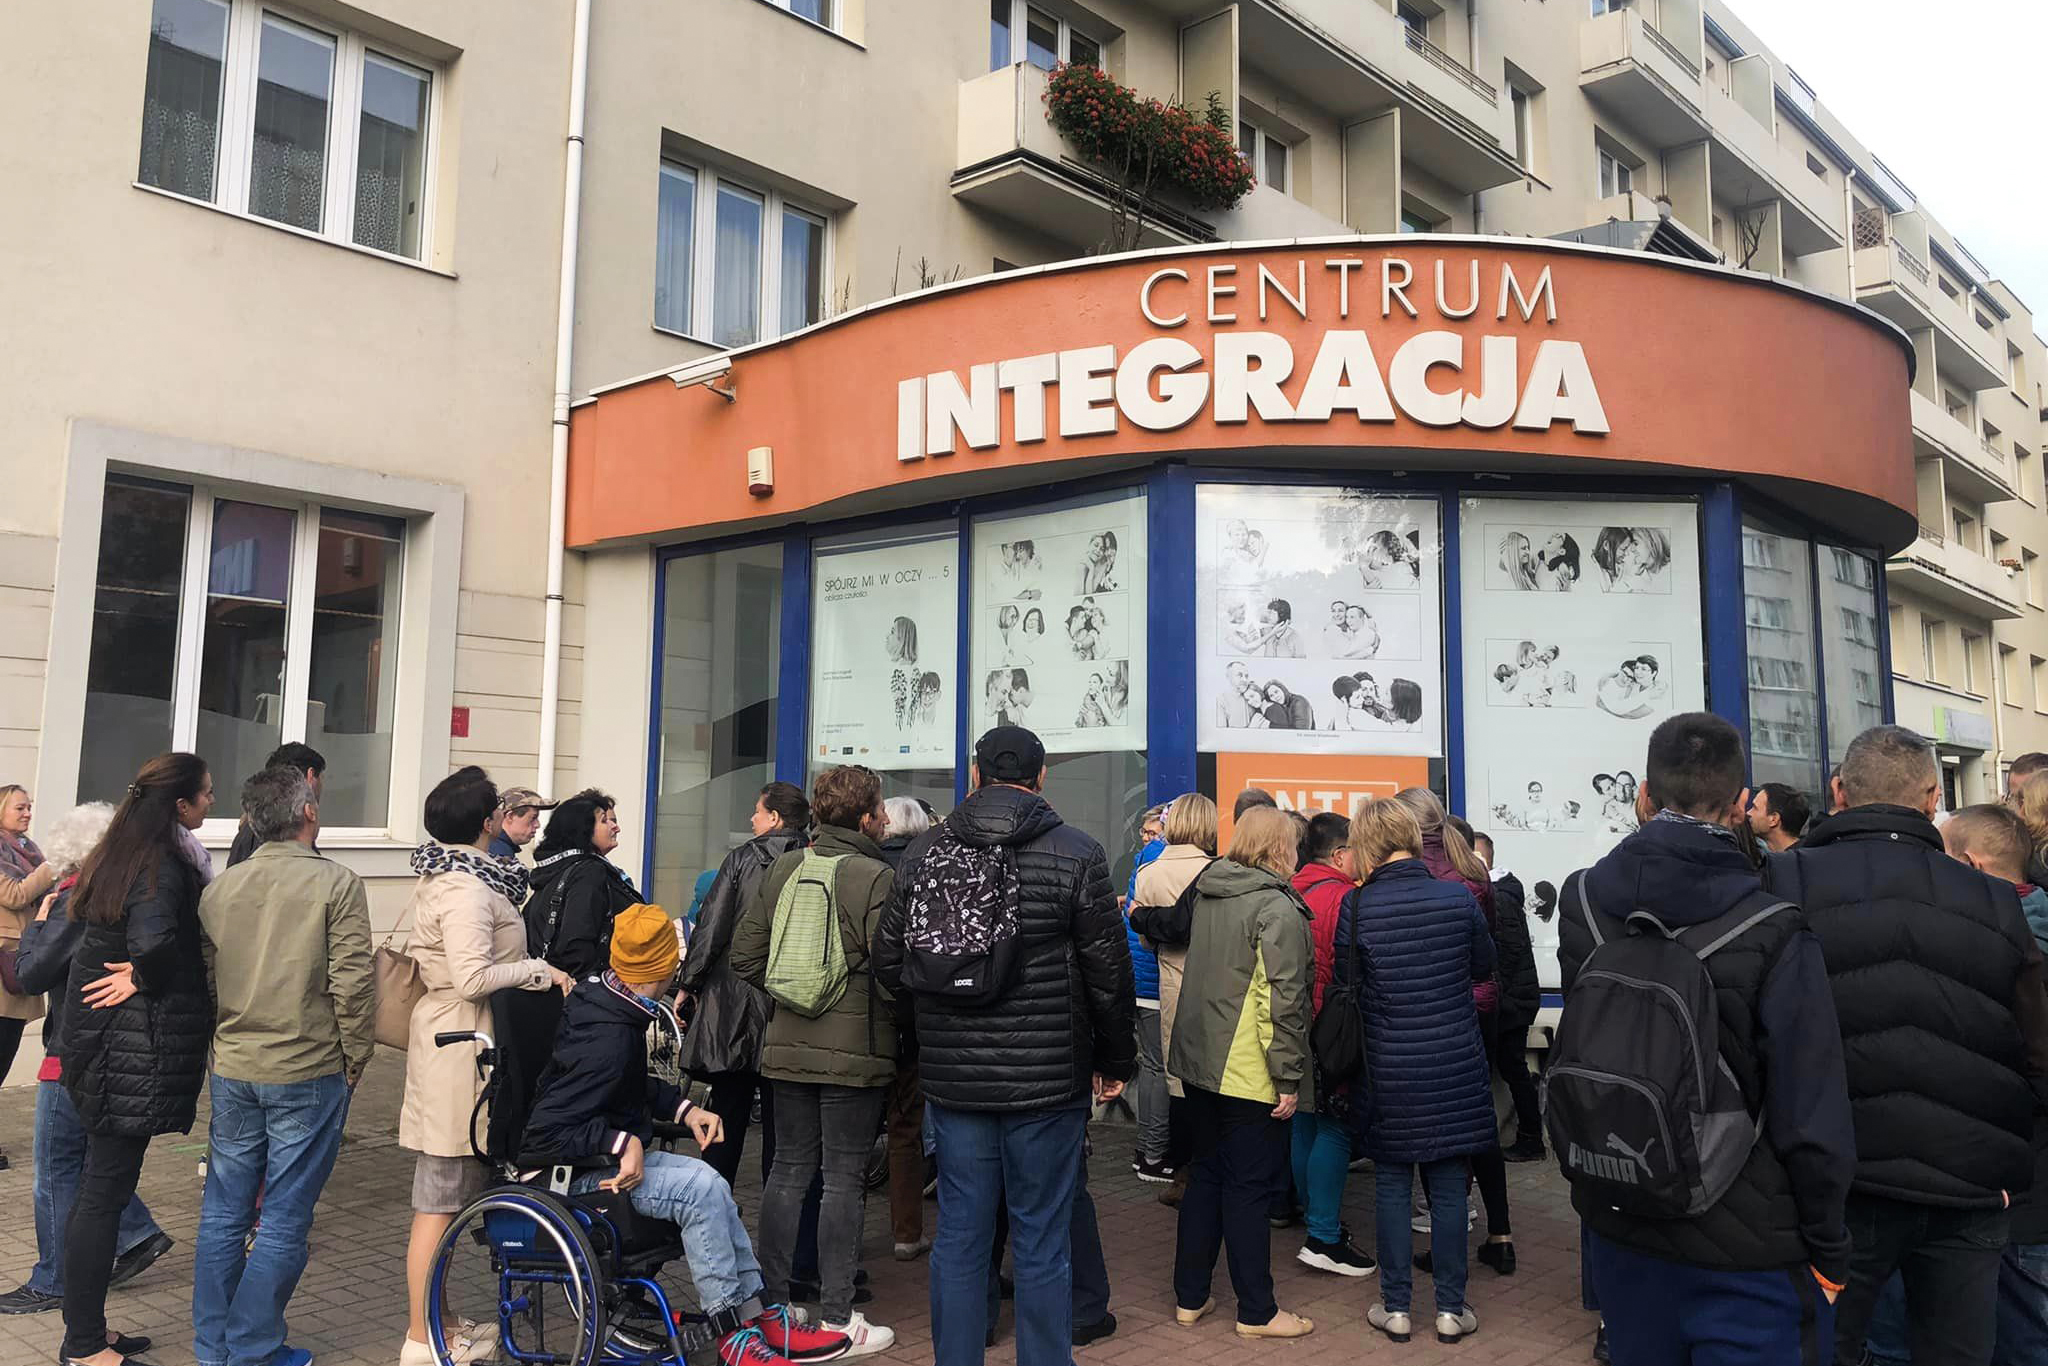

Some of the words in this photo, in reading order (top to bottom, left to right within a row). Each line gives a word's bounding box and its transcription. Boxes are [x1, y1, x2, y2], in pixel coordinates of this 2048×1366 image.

[1140, 257, 1558, 327] CENTRUM
[897, 329, 1611, 463] INTEGRACJA
[824, 576, 858, 592] SPÓJRZ
[861, 574, 874, 588] MI
[879, 573, 889, 585] W
[894, 568, 923, 583] OCZY
[943, 565, 950, 578] 5
[1568, 1141, 1639, 1184] PUMA
